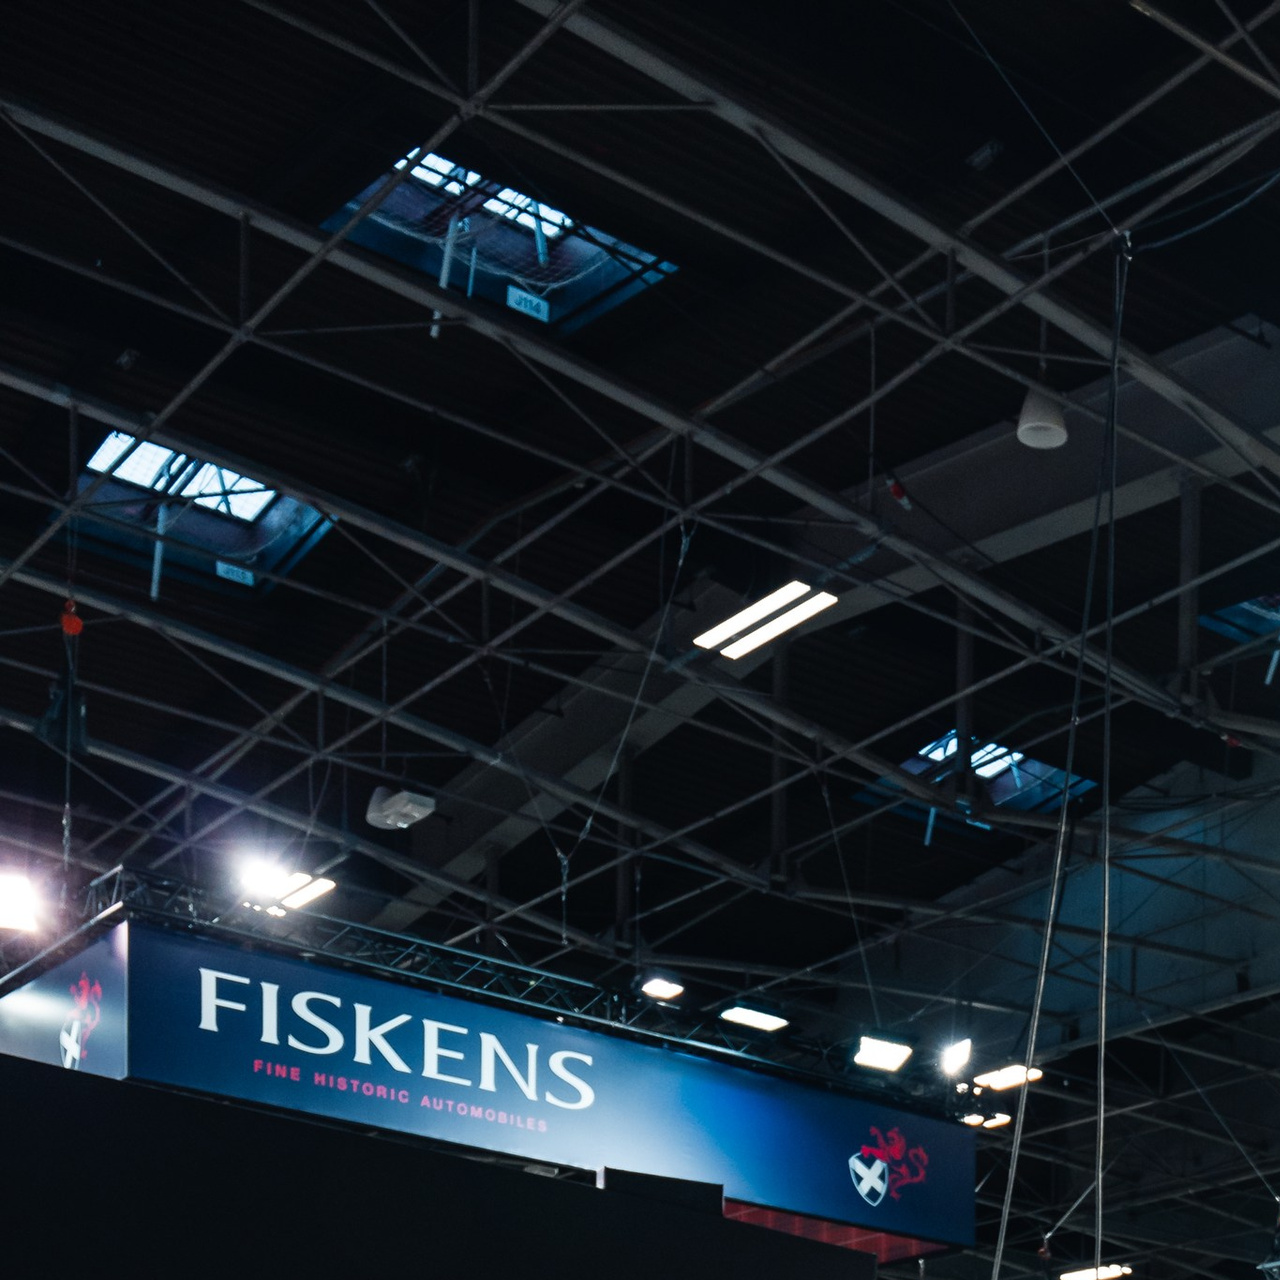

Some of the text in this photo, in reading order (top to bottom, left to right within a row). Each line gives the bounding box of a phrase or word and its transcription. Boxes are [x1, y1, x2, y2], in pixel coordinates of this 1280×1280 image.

[198, 967, 596, 1110] FISKENS
[253, 1060, 549, 1133] FINE HISTORIC AUTOMOBILES
